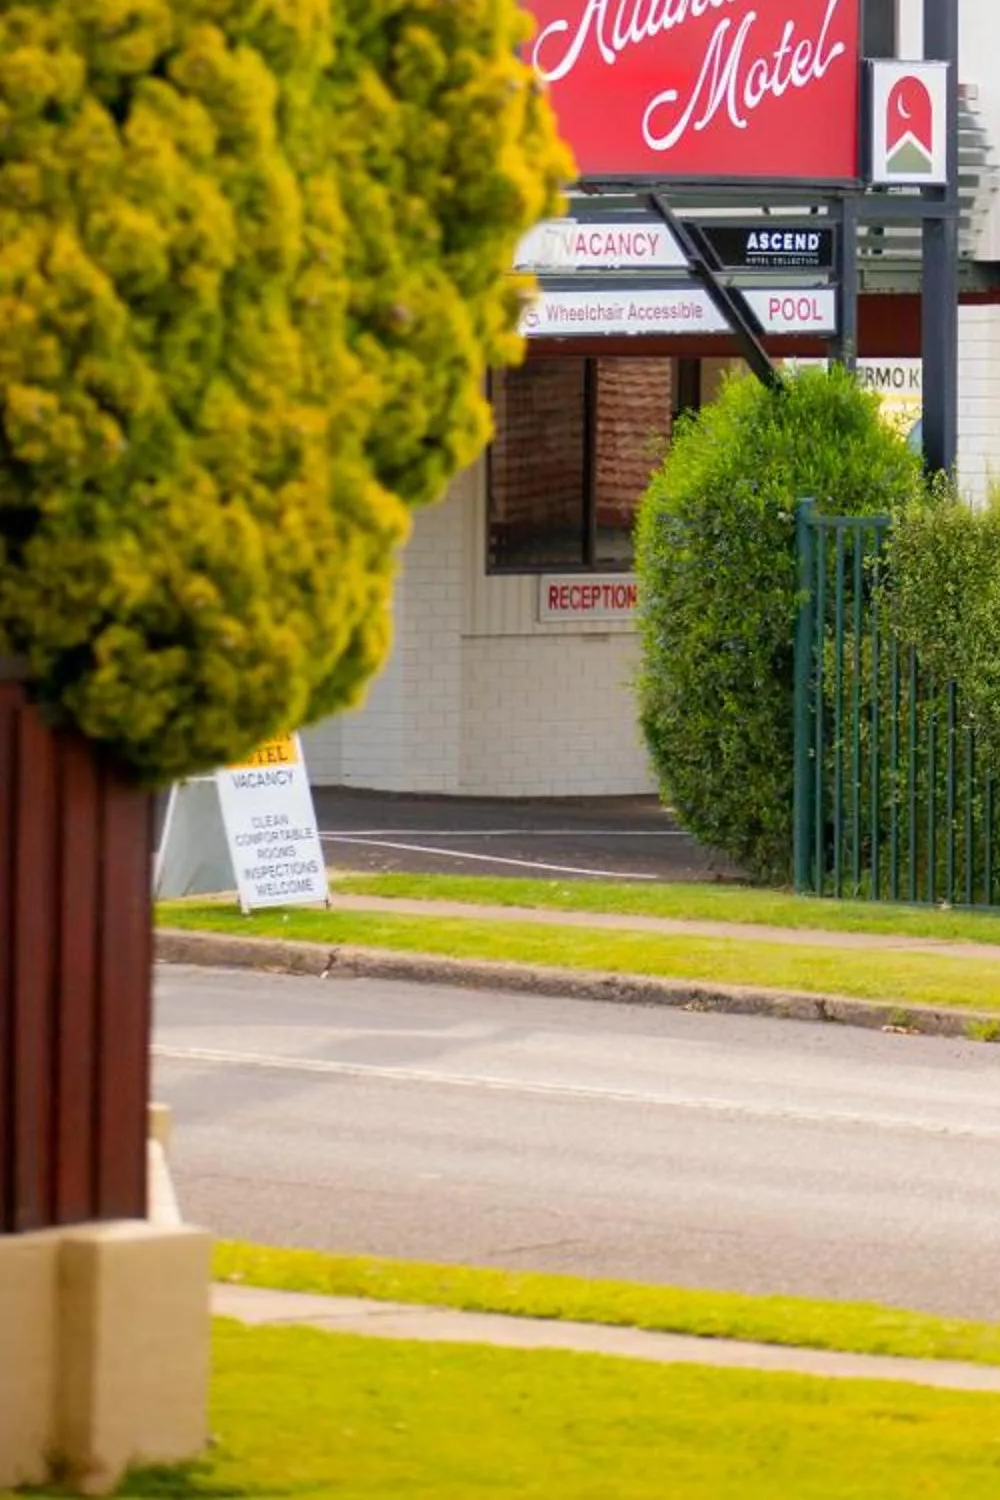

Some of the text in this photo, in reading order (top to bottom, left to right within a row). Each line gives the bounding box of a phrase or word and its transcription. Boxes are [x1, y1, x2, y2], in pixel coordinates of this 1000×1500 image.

[746, 231, 819, 251] ASCEND
[545, 301, 703, 322] Wheelchair Accessible
[768, 297, 823, 321] POOL
[548, 584, 638, 610] RECEPTION
[231, 769, 294, 790] VACANCY
[251, 813, 289, 829] CLEAN
[235, 827, 315, 847] COMFORTABLE
[257, 845, 297, 859] ROOMS
[244, 859, 319, 880] INSPECTIONS
[256, 878, 315, 897] WELCOME
